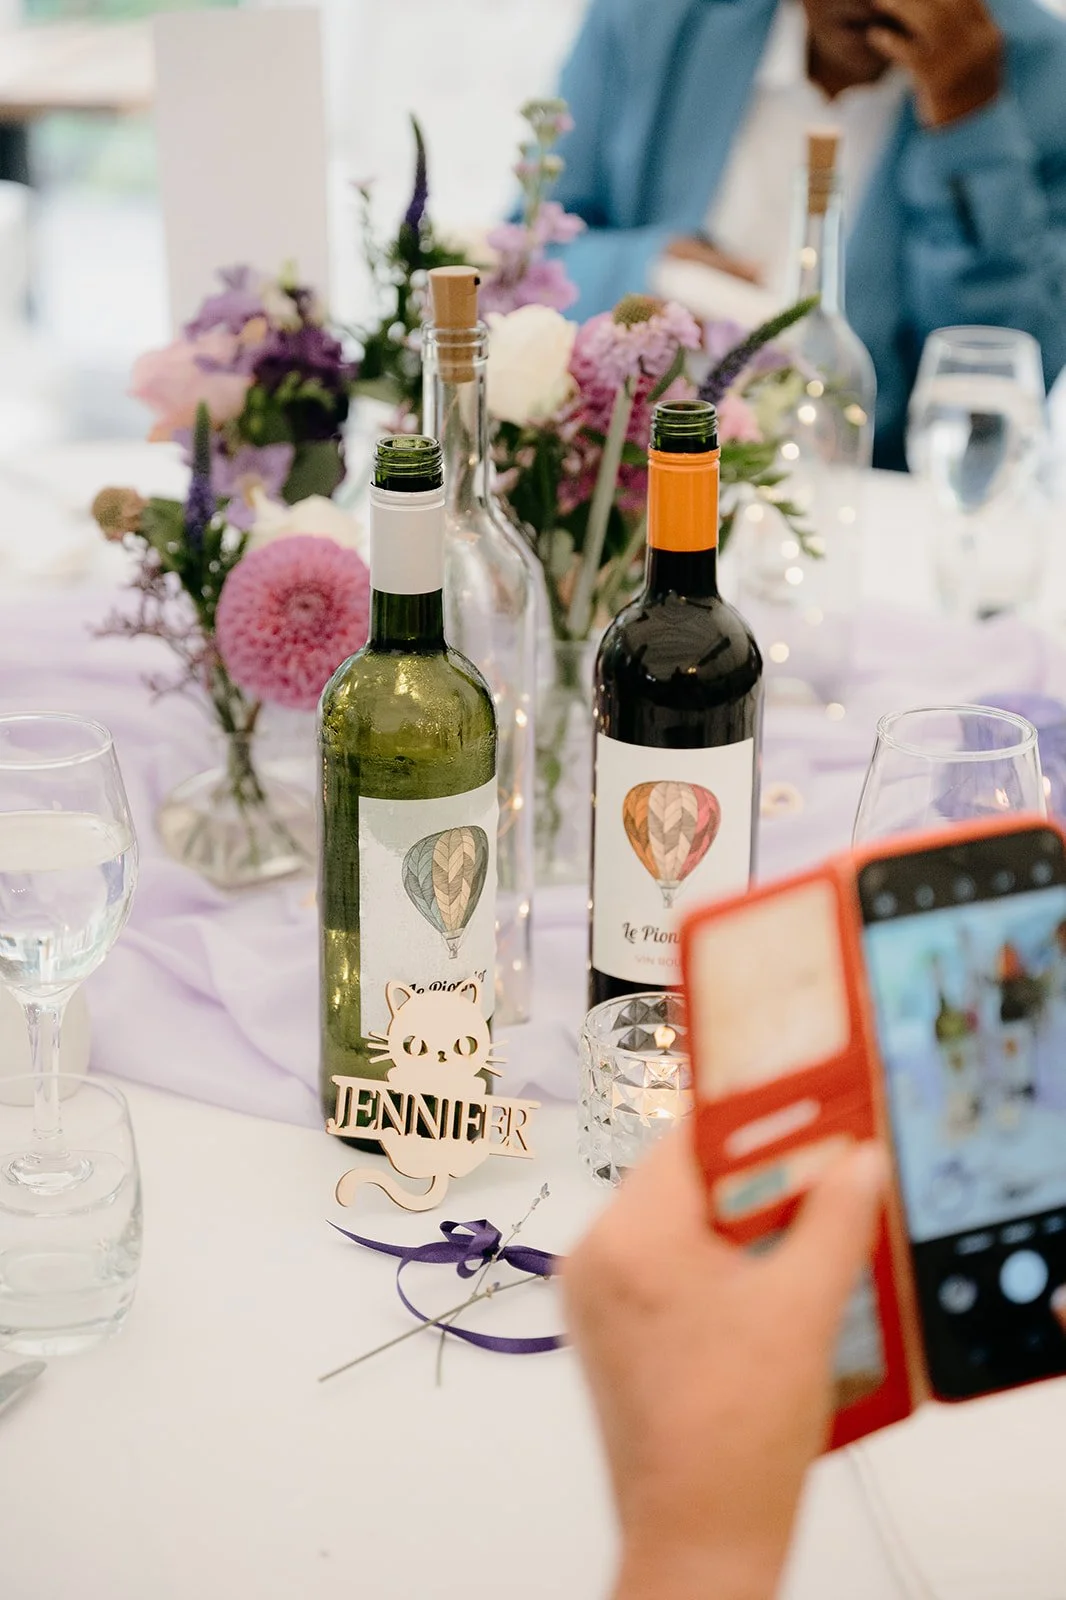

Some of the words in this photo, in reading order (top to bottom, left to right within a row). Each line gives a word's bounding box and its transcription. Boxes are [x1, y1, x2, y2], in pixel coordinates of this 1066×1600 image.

[622, 922, 638, 944] Le
[641, 924, 681, 944] Pion
[634, 953, 655, 966] VIN
[657, 956, 681, 967] ROU
[327, 1081, 530, 1152] JENNIFER
